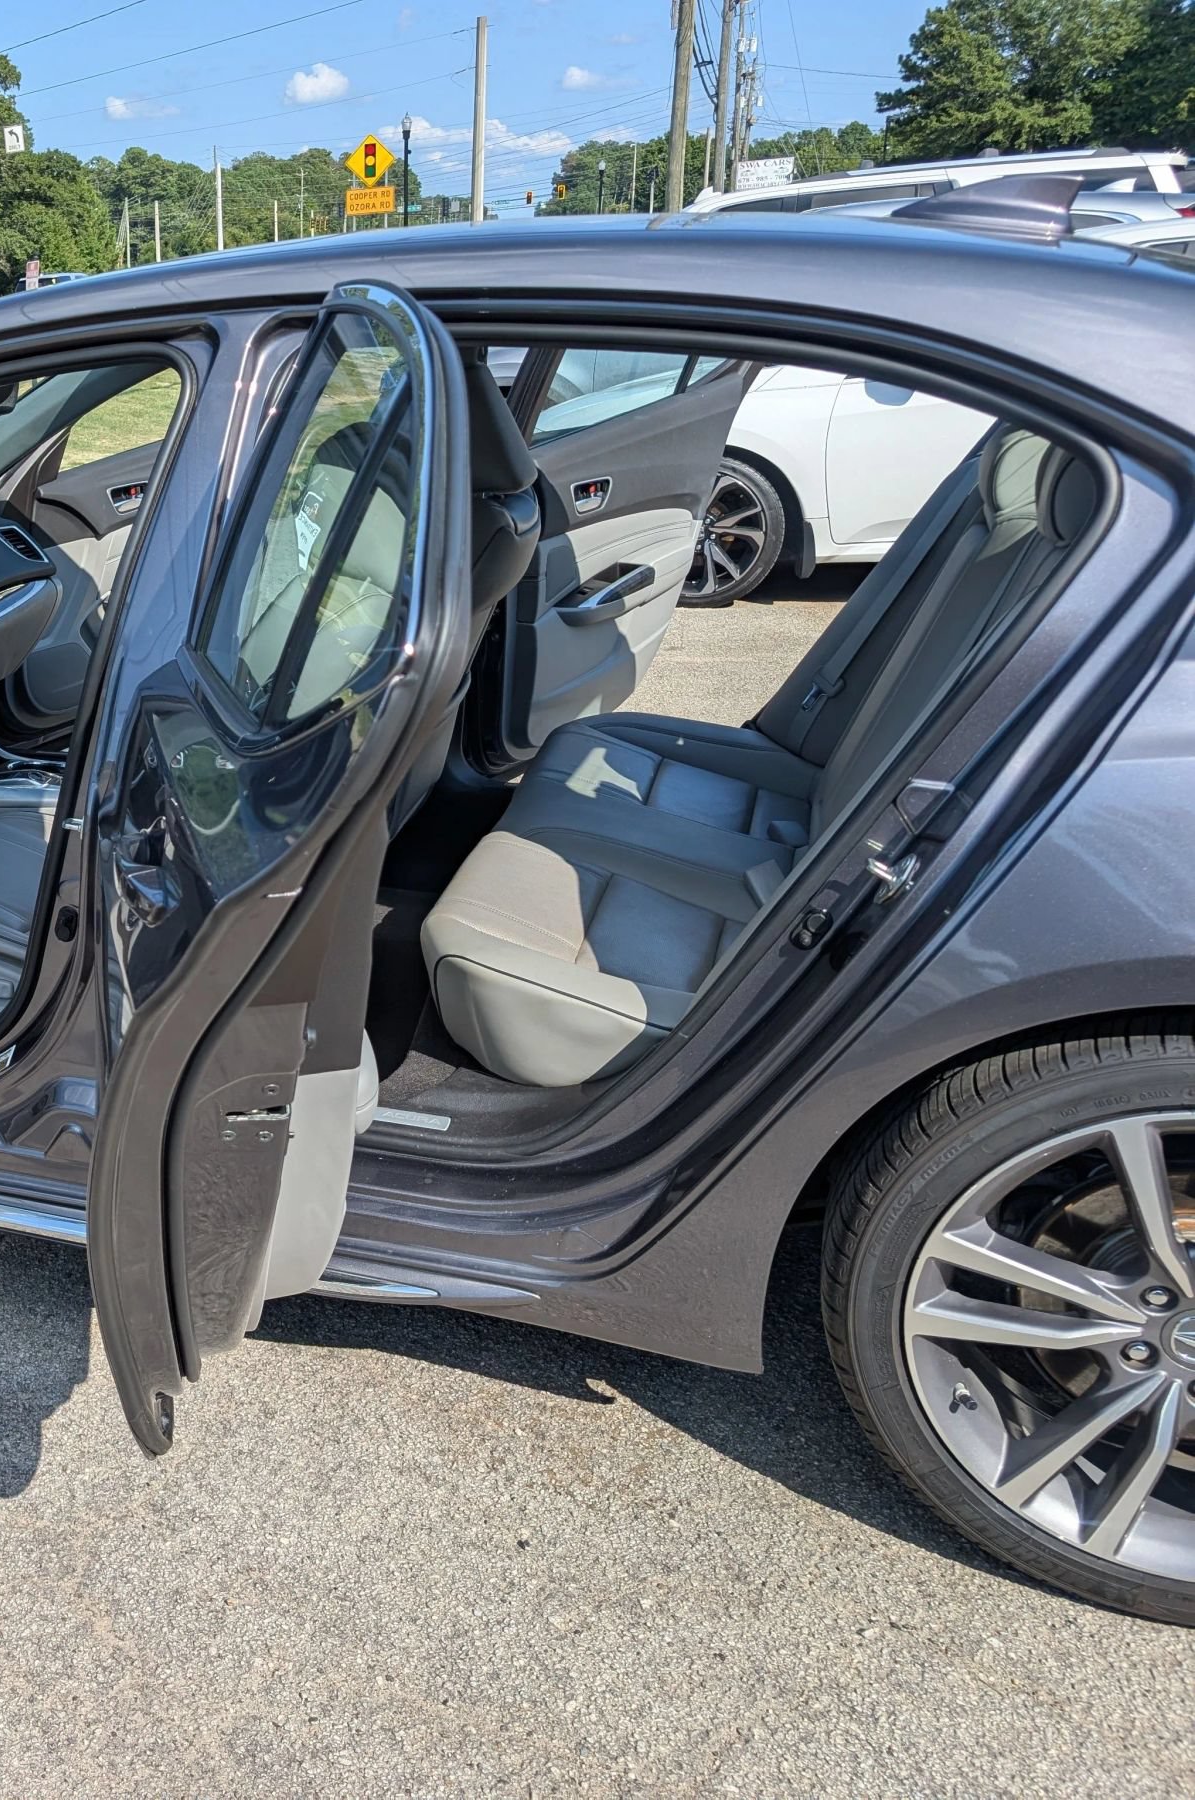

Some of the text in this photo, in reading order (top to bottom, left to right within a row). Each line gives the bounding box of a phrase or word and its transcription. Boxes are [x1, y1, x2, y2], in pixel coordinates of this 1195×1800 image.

[740, 159, 791, 169] SWA CARS
[349, 190, 391, 201] COOPER RD
[349, 201, 391, 211] OZORA RD
[381, 1111, 441, 1125] ACURA
